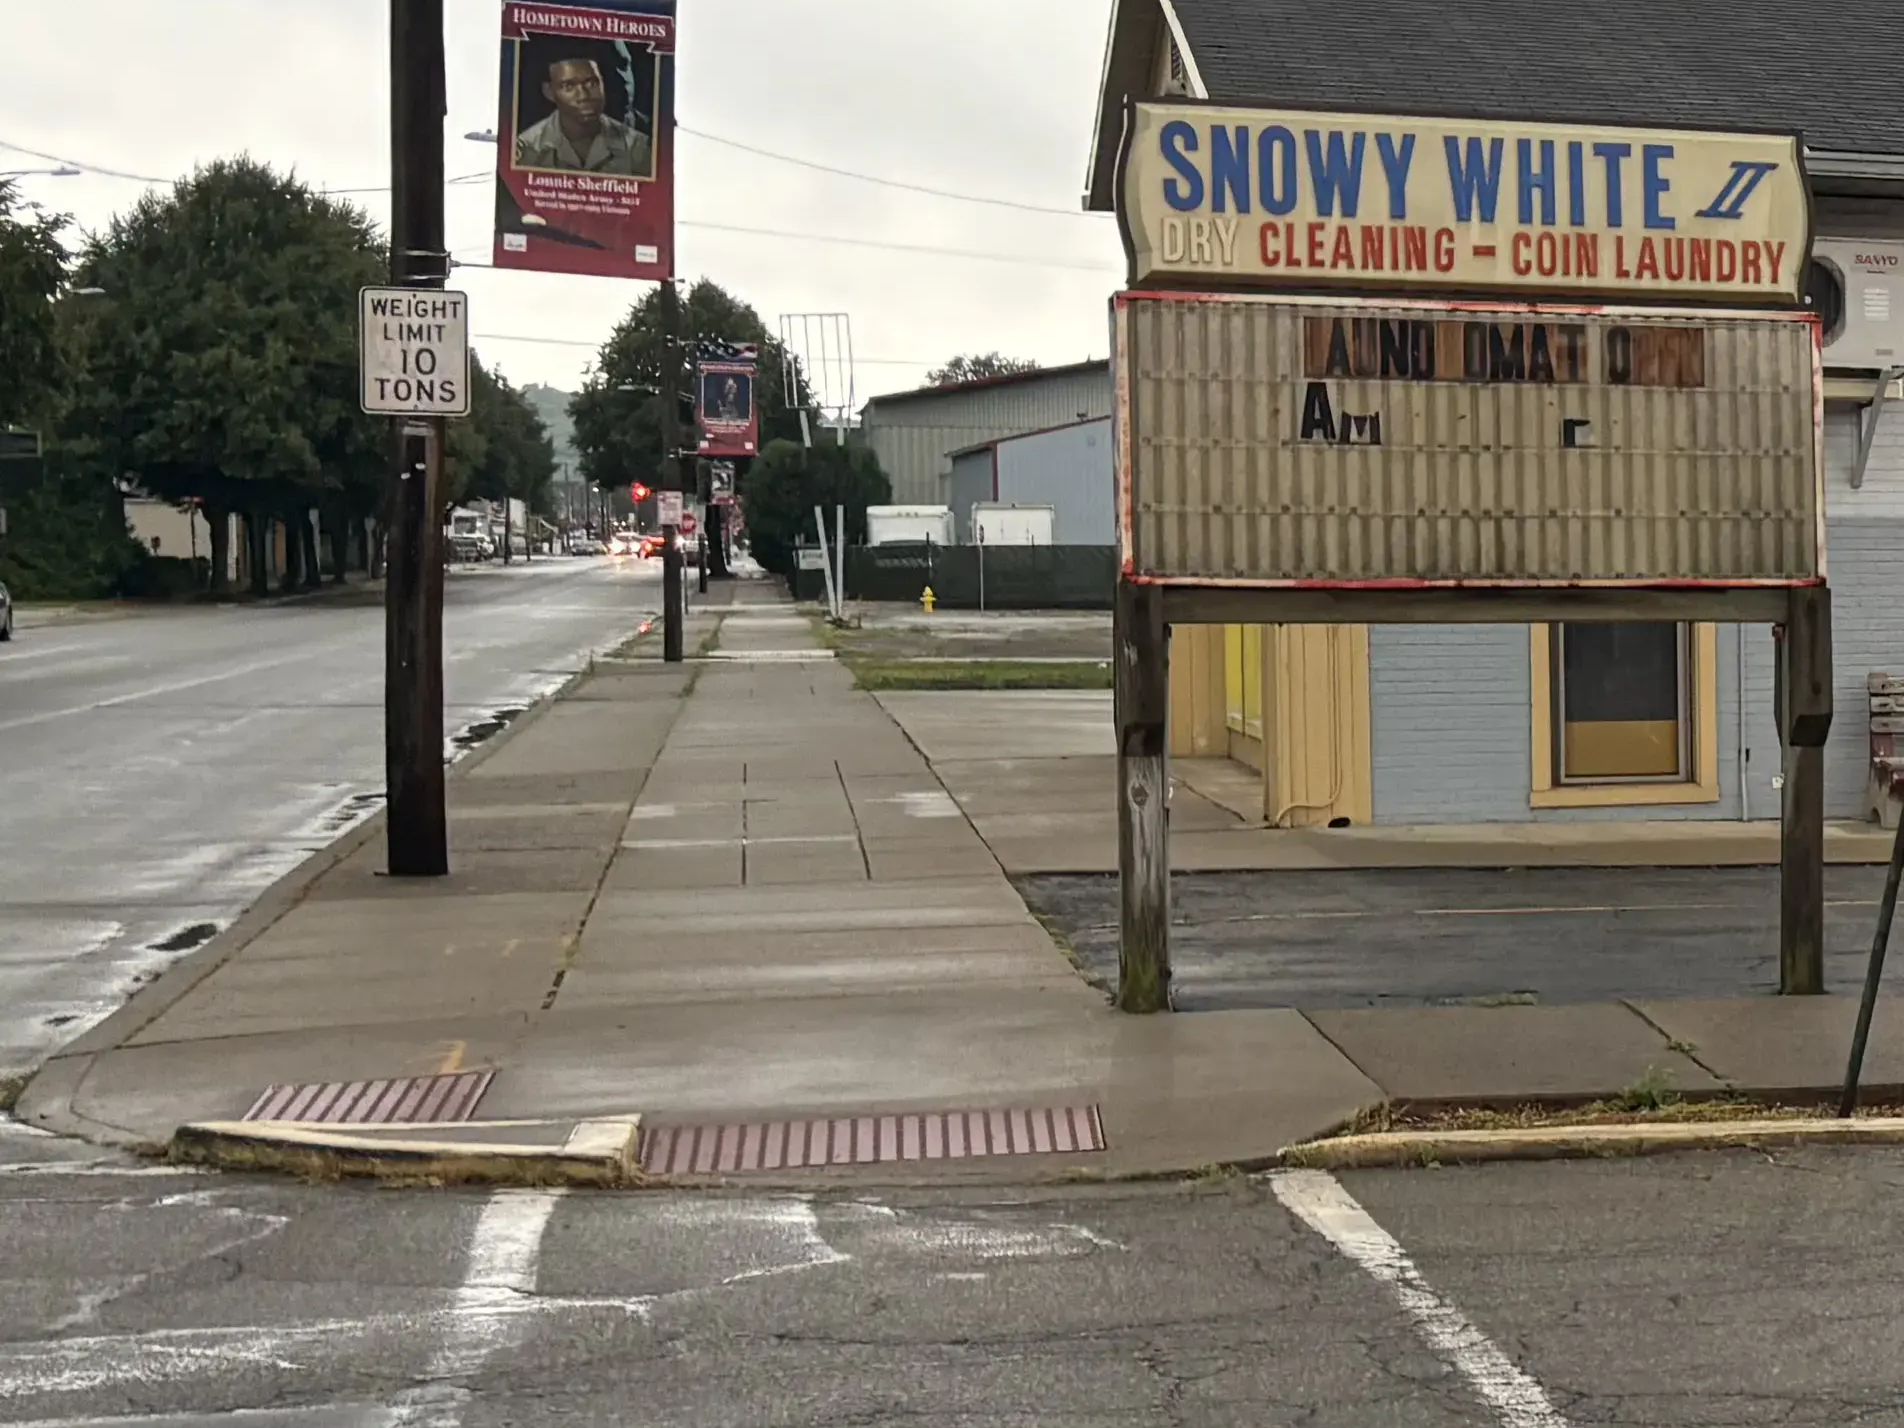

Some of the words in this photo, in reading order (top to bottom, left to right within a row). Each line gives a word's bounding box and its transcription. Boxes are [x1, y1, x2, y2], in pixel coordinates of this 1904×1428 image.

[512, 7, 602, 32] HOMETOWN
[606, 17, 666, 37] HEROES
[527, 172, 575, 189] Lonnie
[577, 176, 639, 195] Sheffield
[1159, 120, 1416, 220] SNOWY
[1443, 135, 1676, 230] WHITE
[1694, 160, 1779, 220] II
[1161, 215, 1240, 265] DRY
[1259, 221, 1455, 273] CLEANING
[1512, 231, 1599, 278] COIN
[1614, 235, 1786, 285] LAUNDRY
[1854, 253, 1899, 267] SANYO
[371, 297, 461, 319] WEIGHT
[383, 322, 446, 343] LIMIT
[401, 347, 437, 375] 10
[374, 377, 456, 403] TONS
